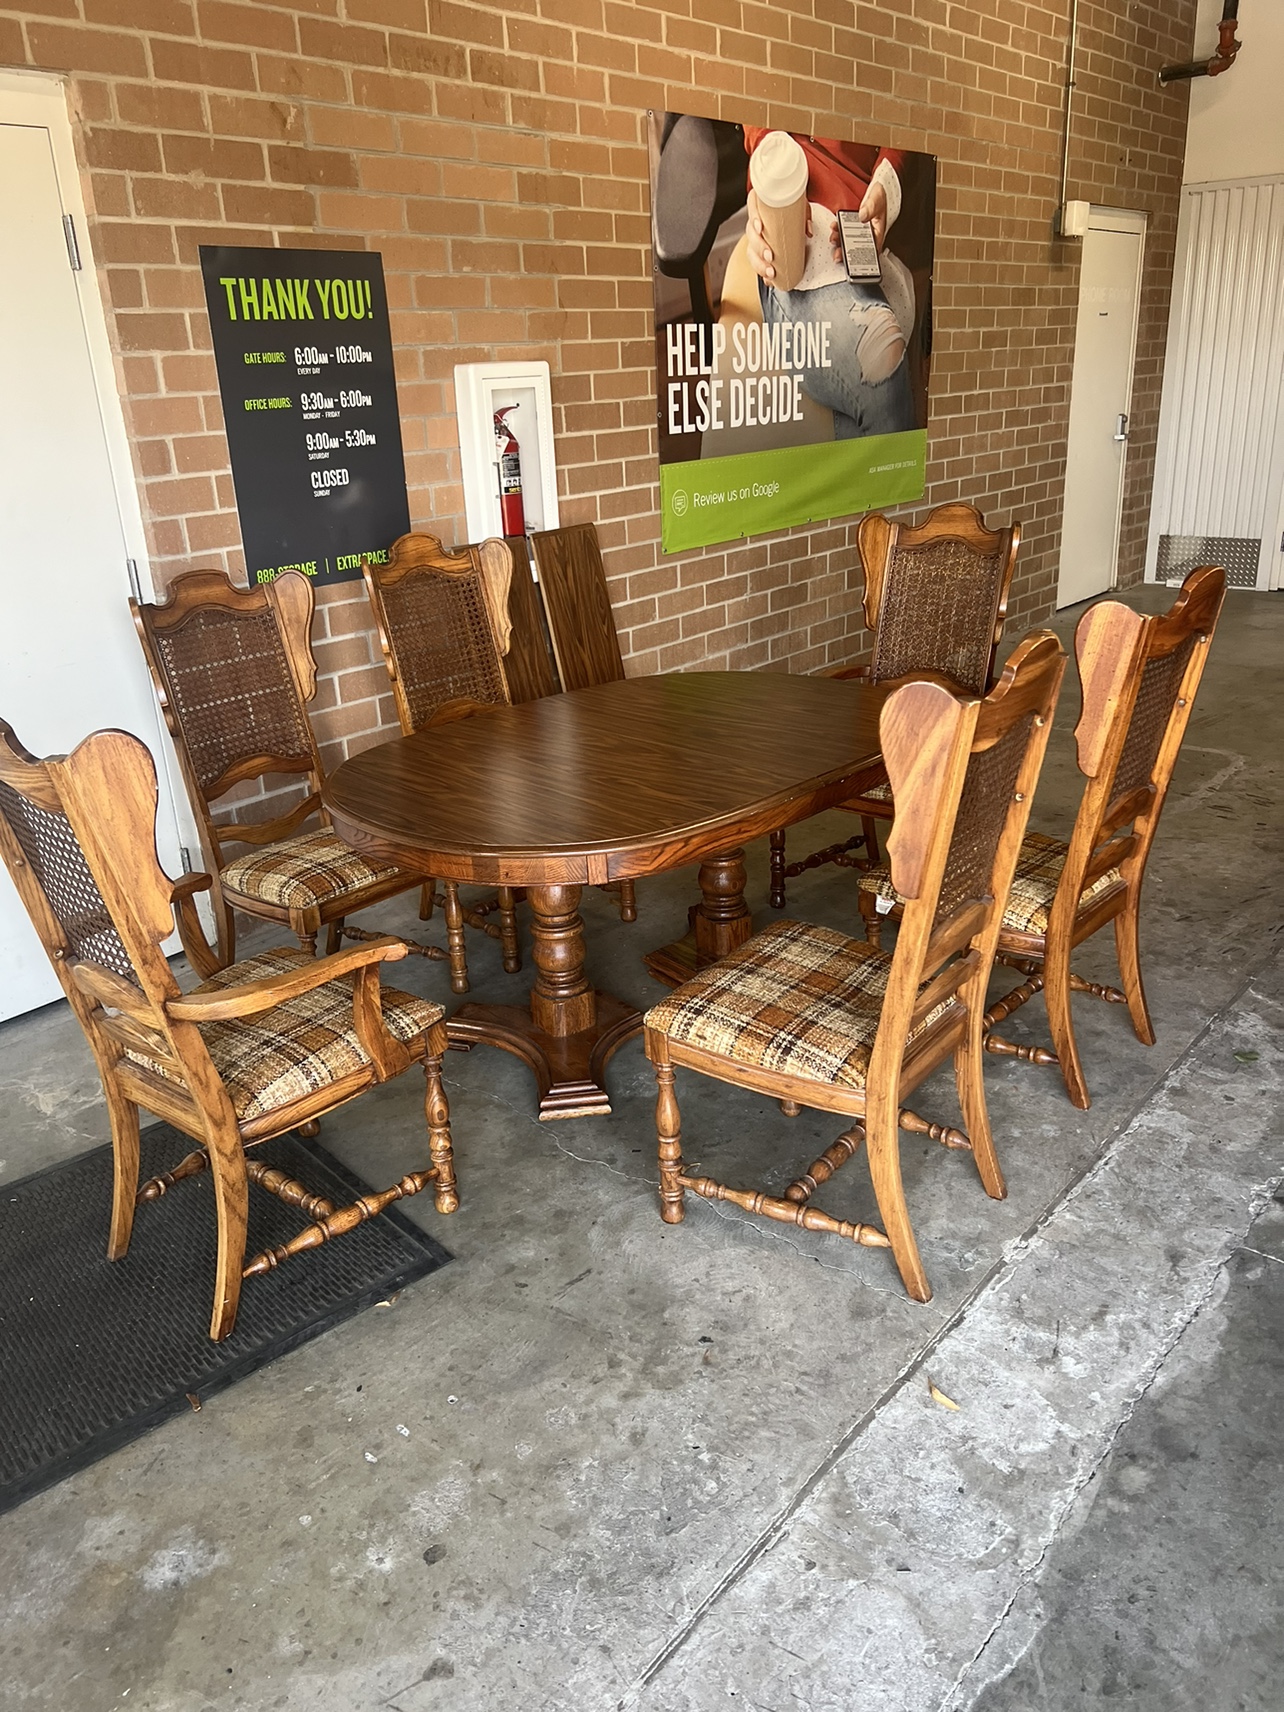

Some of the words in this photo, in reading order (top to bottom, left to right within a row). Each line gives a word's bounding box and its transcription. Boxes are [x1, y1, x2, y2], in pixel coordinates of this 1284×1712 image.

[219, 277, 314, 320] THANK
[314, 279, 373, 319] YOU!
[243, 352, 261, 364] GATE
[262, 351, 287, 363] HOURS:
[294, 346, 329, 365] 6:00AM
[335, 345, 373, 364] 10:00PM
[666, 322, 726, 377] HELP
[732, 321, 832, 374] SOMEONE
[297, 368, 311, 376] EVERY
[312, 367, 321, 375] DAY
[244, 399, 268, 411] OFFICE
[268, 397, 292, 409] HOURS:
[300, 392, 334, 411] 9:30AM
[339, 390, 373, 408] 6:00PM
[667, 379, 724, 434] ELSE
[730, 374, 804, 428] DECIDE
[302, 412, 321, 420] MONDAY
[325, 411, 341, 419] FRIDAY
[305, 432, 340, 451] 9:00AM
[344, 429, 377, 448] 5:30PM
[308, 452, 330, 461] SATURDAY
[310, 468, 350, 489] CLOSED
[313, 489, 331, 498] SUNDAY
[693, 490, 725, 508] Review
[727, 489, 738, 502] us
[739, 487, 751, 500] on
[752, 480, 780, 498] Google
[256, 561, 318, 584] 888-AGE
[336, 549, 390, 571] EXTRAPACE.
